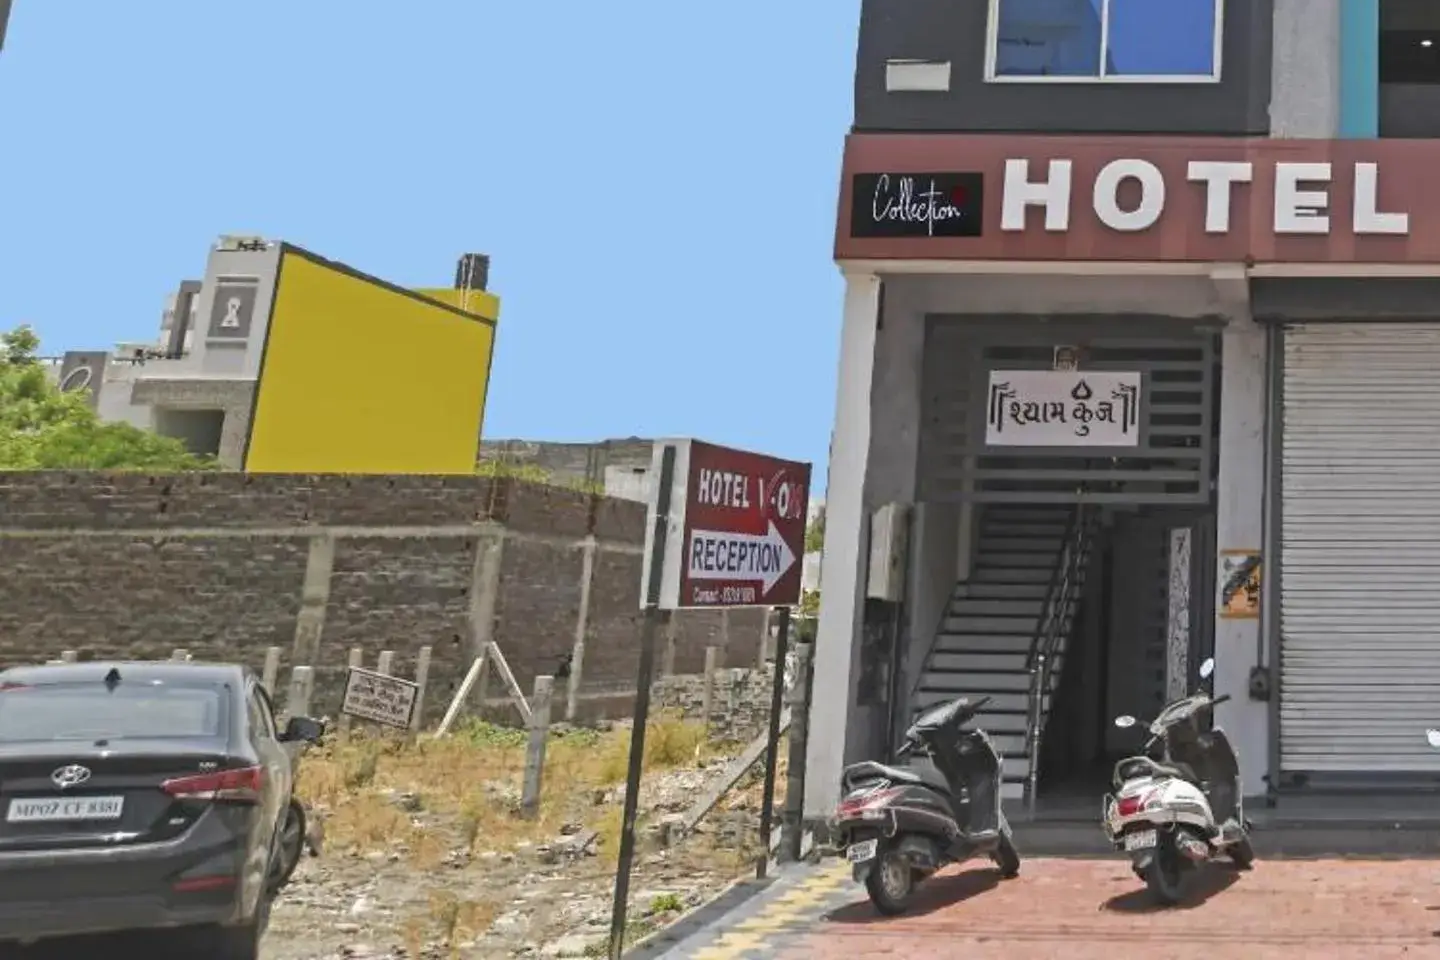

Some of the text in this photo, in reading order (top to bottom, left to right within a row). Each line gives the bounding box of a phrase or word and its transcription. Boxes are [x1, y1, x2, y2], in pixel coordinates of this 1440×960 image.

[872, 173, 962, 237] Collection
[1000, 158, 1409, 234] HOTEL
[697, 468, 750, 508] HOTEL
[691, 536, 783, 574] RECEPTION
